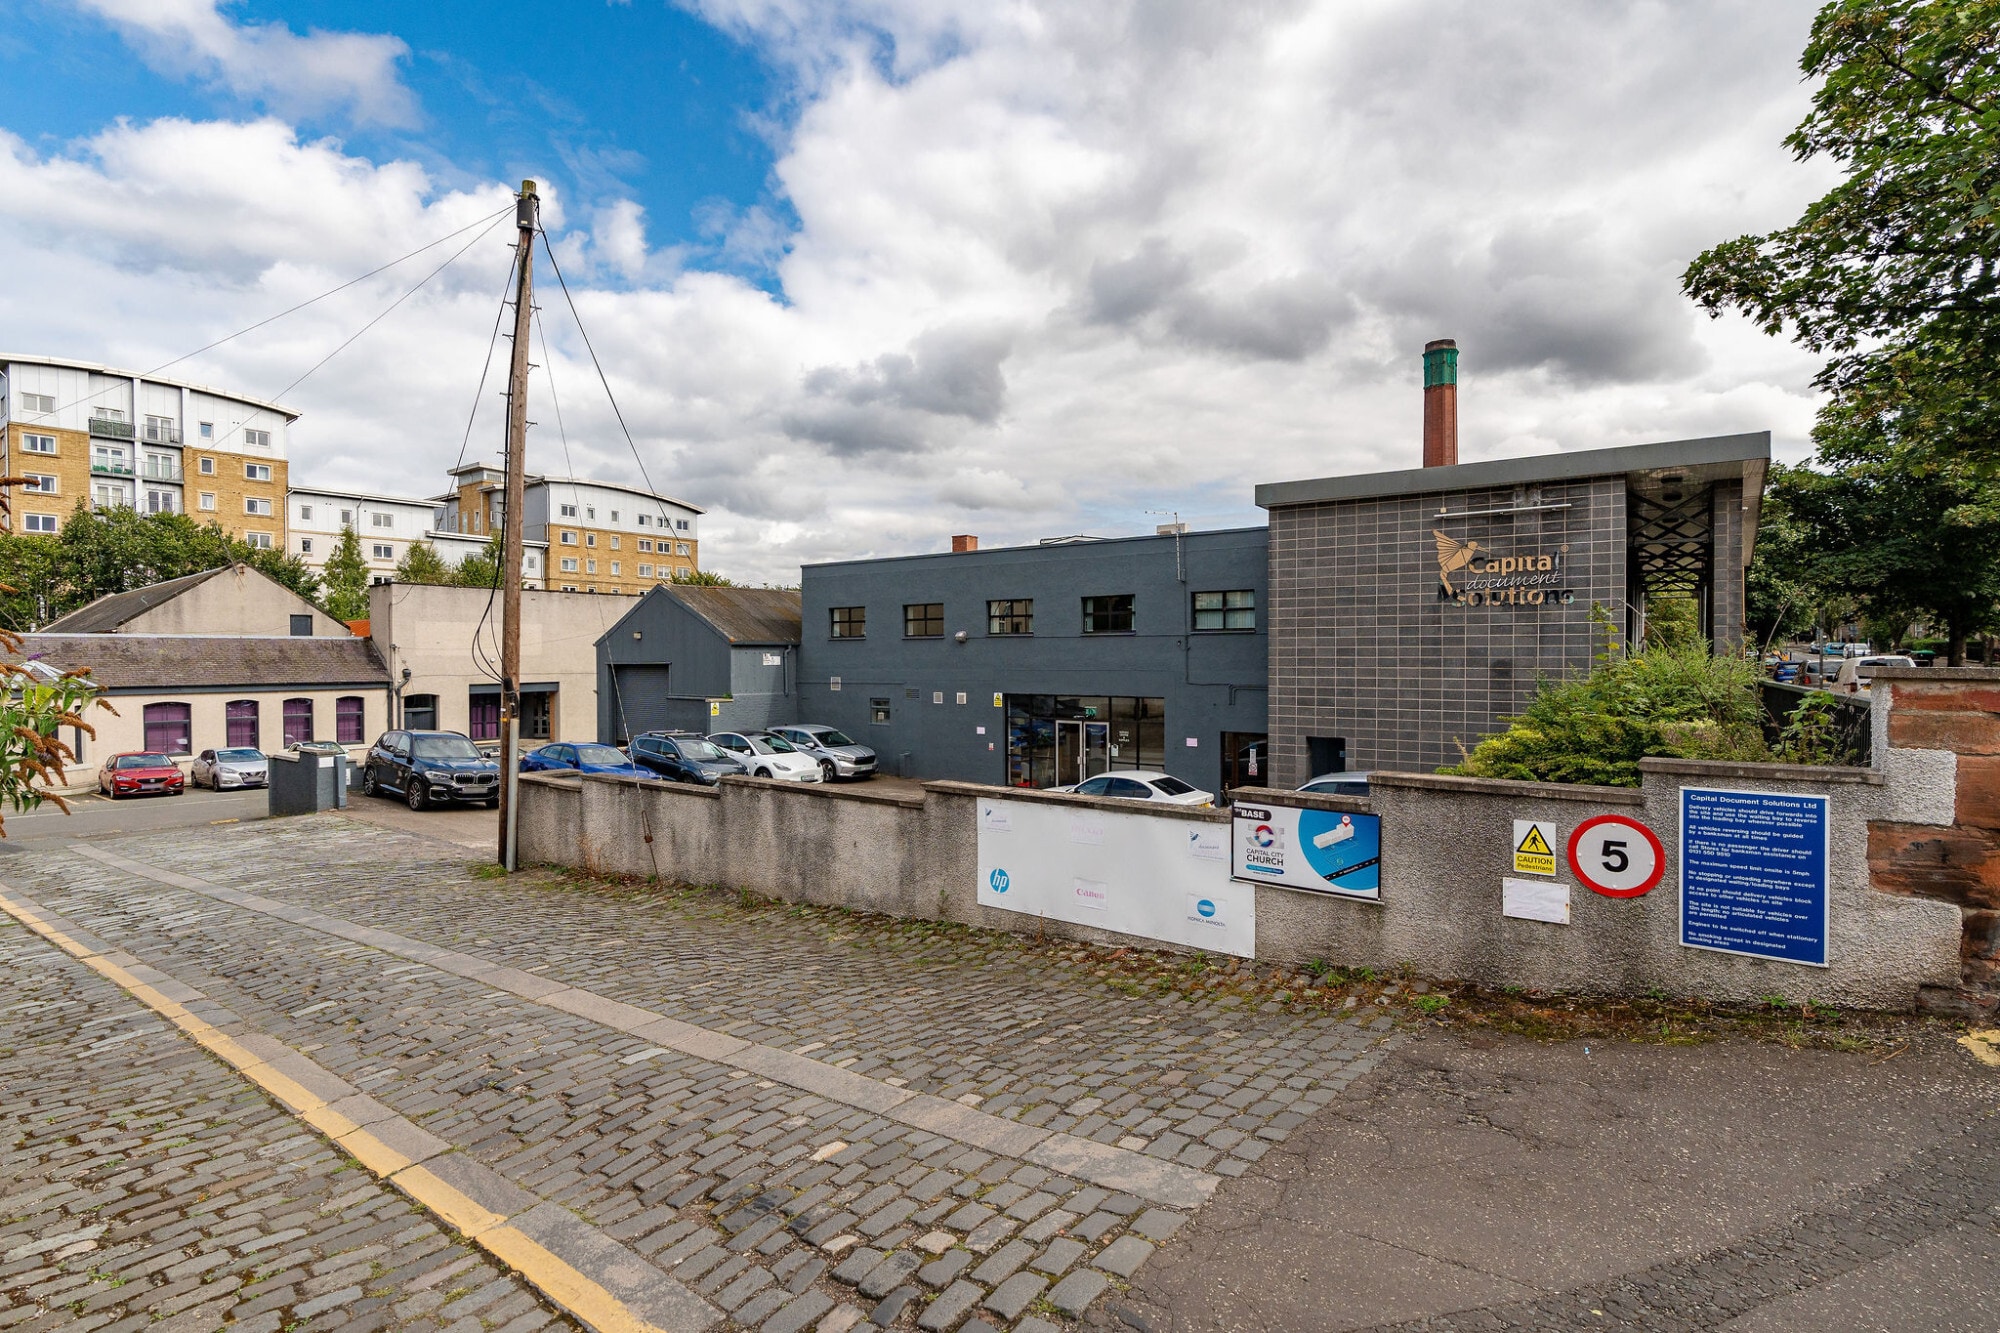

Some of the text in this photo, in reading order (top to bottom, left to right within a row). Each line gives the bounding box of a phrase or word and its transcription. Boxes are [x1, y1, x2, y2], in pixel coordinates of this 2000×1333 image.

[1469, 550, 1560, 576] Capital
[1466, 570, 1562, 590] document
[1691, 795, 1717, 803] Capital
[1720, 797, 1759, 805] Document
[1763, 800, 1800, 808] Solutions
[1241, 809, 1265, 819] BASE
[1246, 848, 1269, 856] CAPITAL
[1601, 839, 1629, 873] 5
[1246, 855, 1284, 866] CHURCH
[1517, 855, 1553, 865] CAUTION
[1517, 863, 1553, 872] Pedestrians
[992, 869, 1008, 893] hp
[1696, 876, 1726, 884] designated
[1729, 880, 1773, 889] waiting/loading
[1699, 871, 1723, 879] stopping
[1733, 875, 1761, 883] unloading
[1764, 878, 1792, 886] anywhere
[1076, 888, 1105, 899] Canon
[1700, 912, 1727, 920] permitted
[1732, 911, 1763, 919] articulated
[1205, 919, 1225, 927] MINOLTA
[1688, 936, 1712, 944] smoking
[1730, 926, 1756, 934] switched
[1787, 934, 1818, 943] stationary
[1753, 940, 1786, 949] designated
